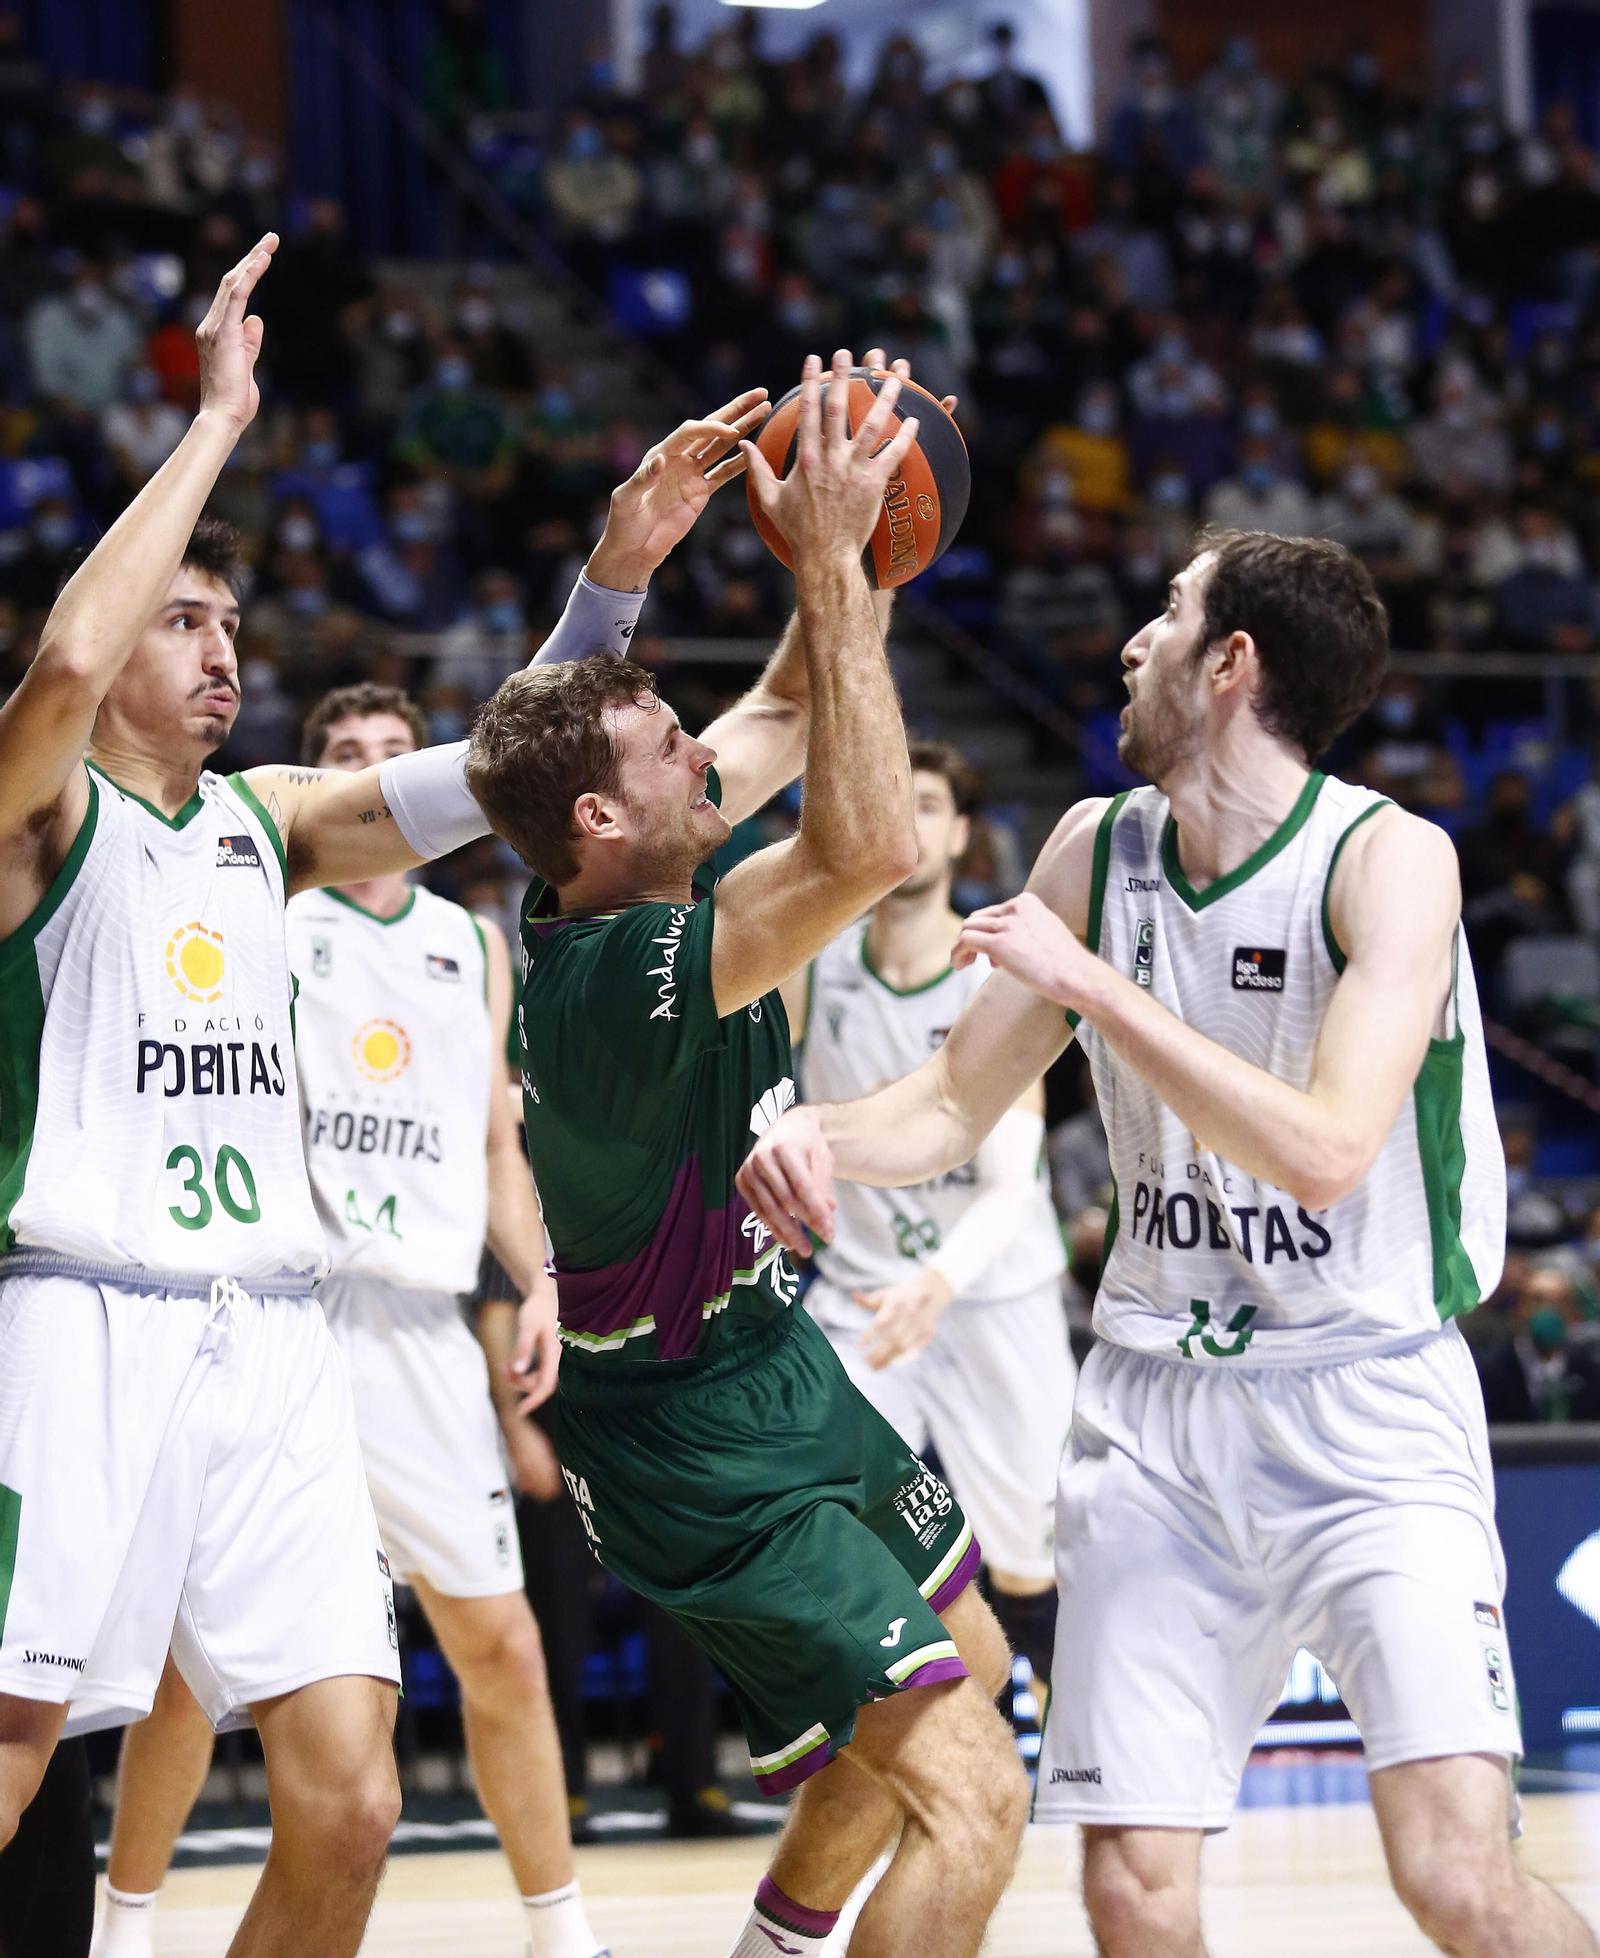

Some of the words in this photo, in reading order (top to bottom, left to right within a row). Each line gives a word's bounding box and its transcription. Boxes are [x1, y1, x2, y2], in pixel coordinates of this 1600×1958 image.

[1235, 974, 1283, 988] endesa
[166, 1144, 260, 1231] 30
[23, 1650, 88, 1674] SPALDING
[1049, 1766, 1102, 1785] SPALDING
